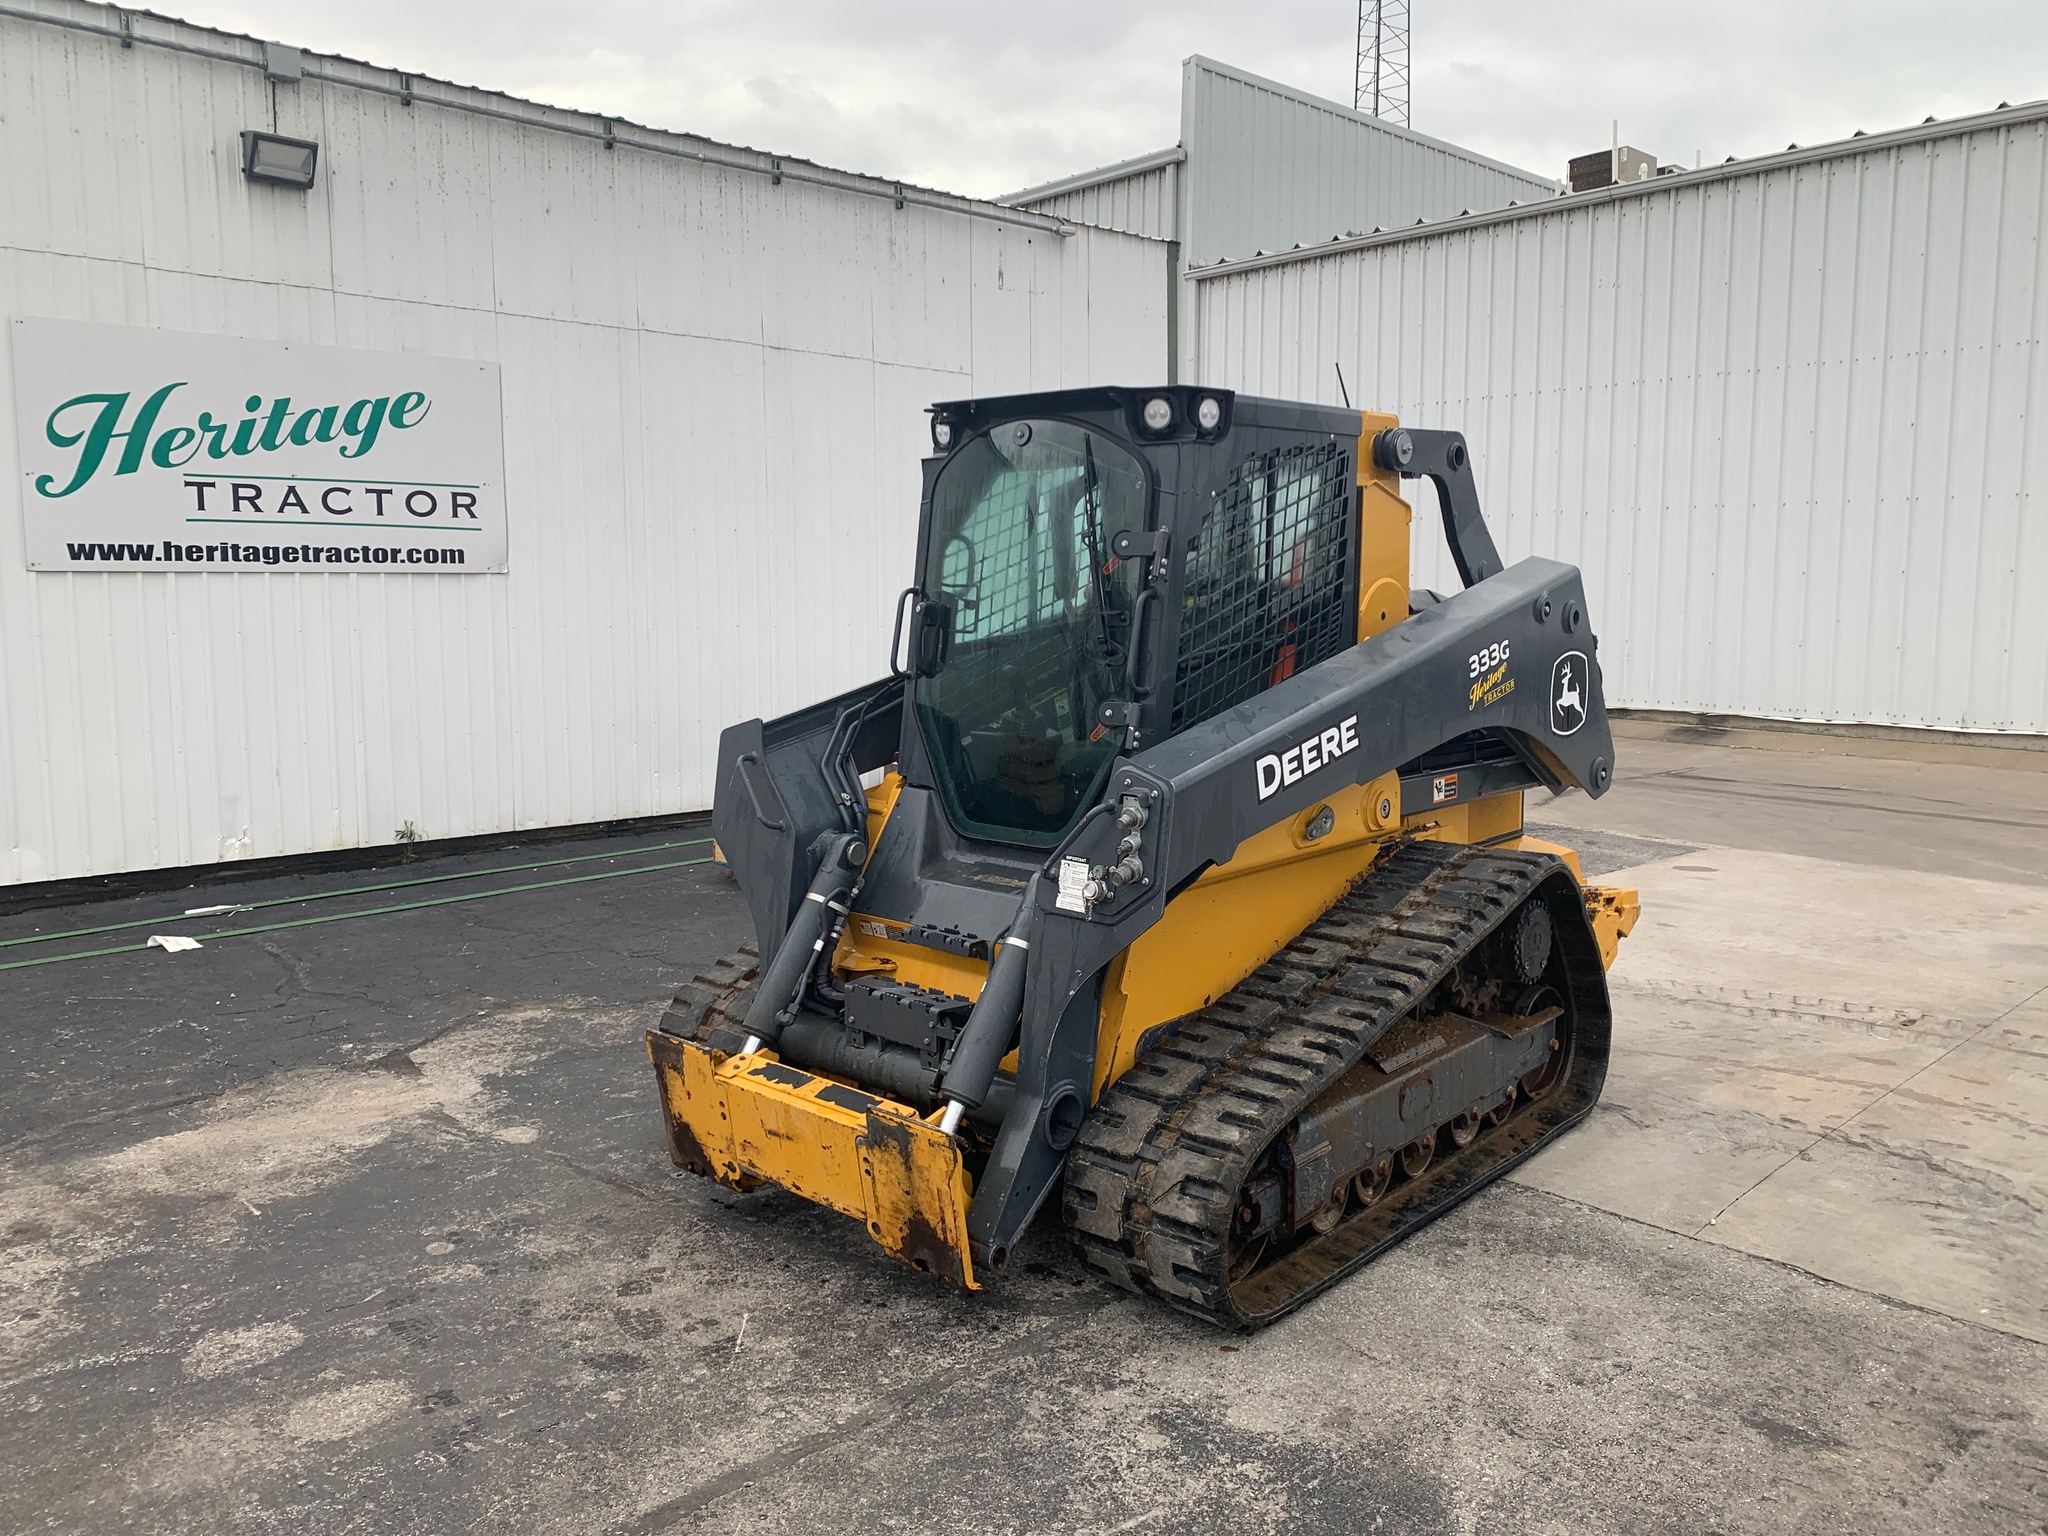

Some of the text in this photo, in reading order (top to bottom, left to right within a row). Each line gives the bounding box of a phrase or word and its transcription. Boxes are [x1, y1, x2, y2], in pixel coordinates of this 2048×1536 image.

[34, 382, 432, 498] Heritage
[183, 480, 479, 519] TRACTOR
[66, 540, 465, 566] www.heritagetractor.com
[1468, 639, 1510, 679] 333G
[1468, 661, 1508, 711] Heritage
[1483, 680, 1515, 704] TRACTOR
[1255, 715, 1360, 801] DEERE
